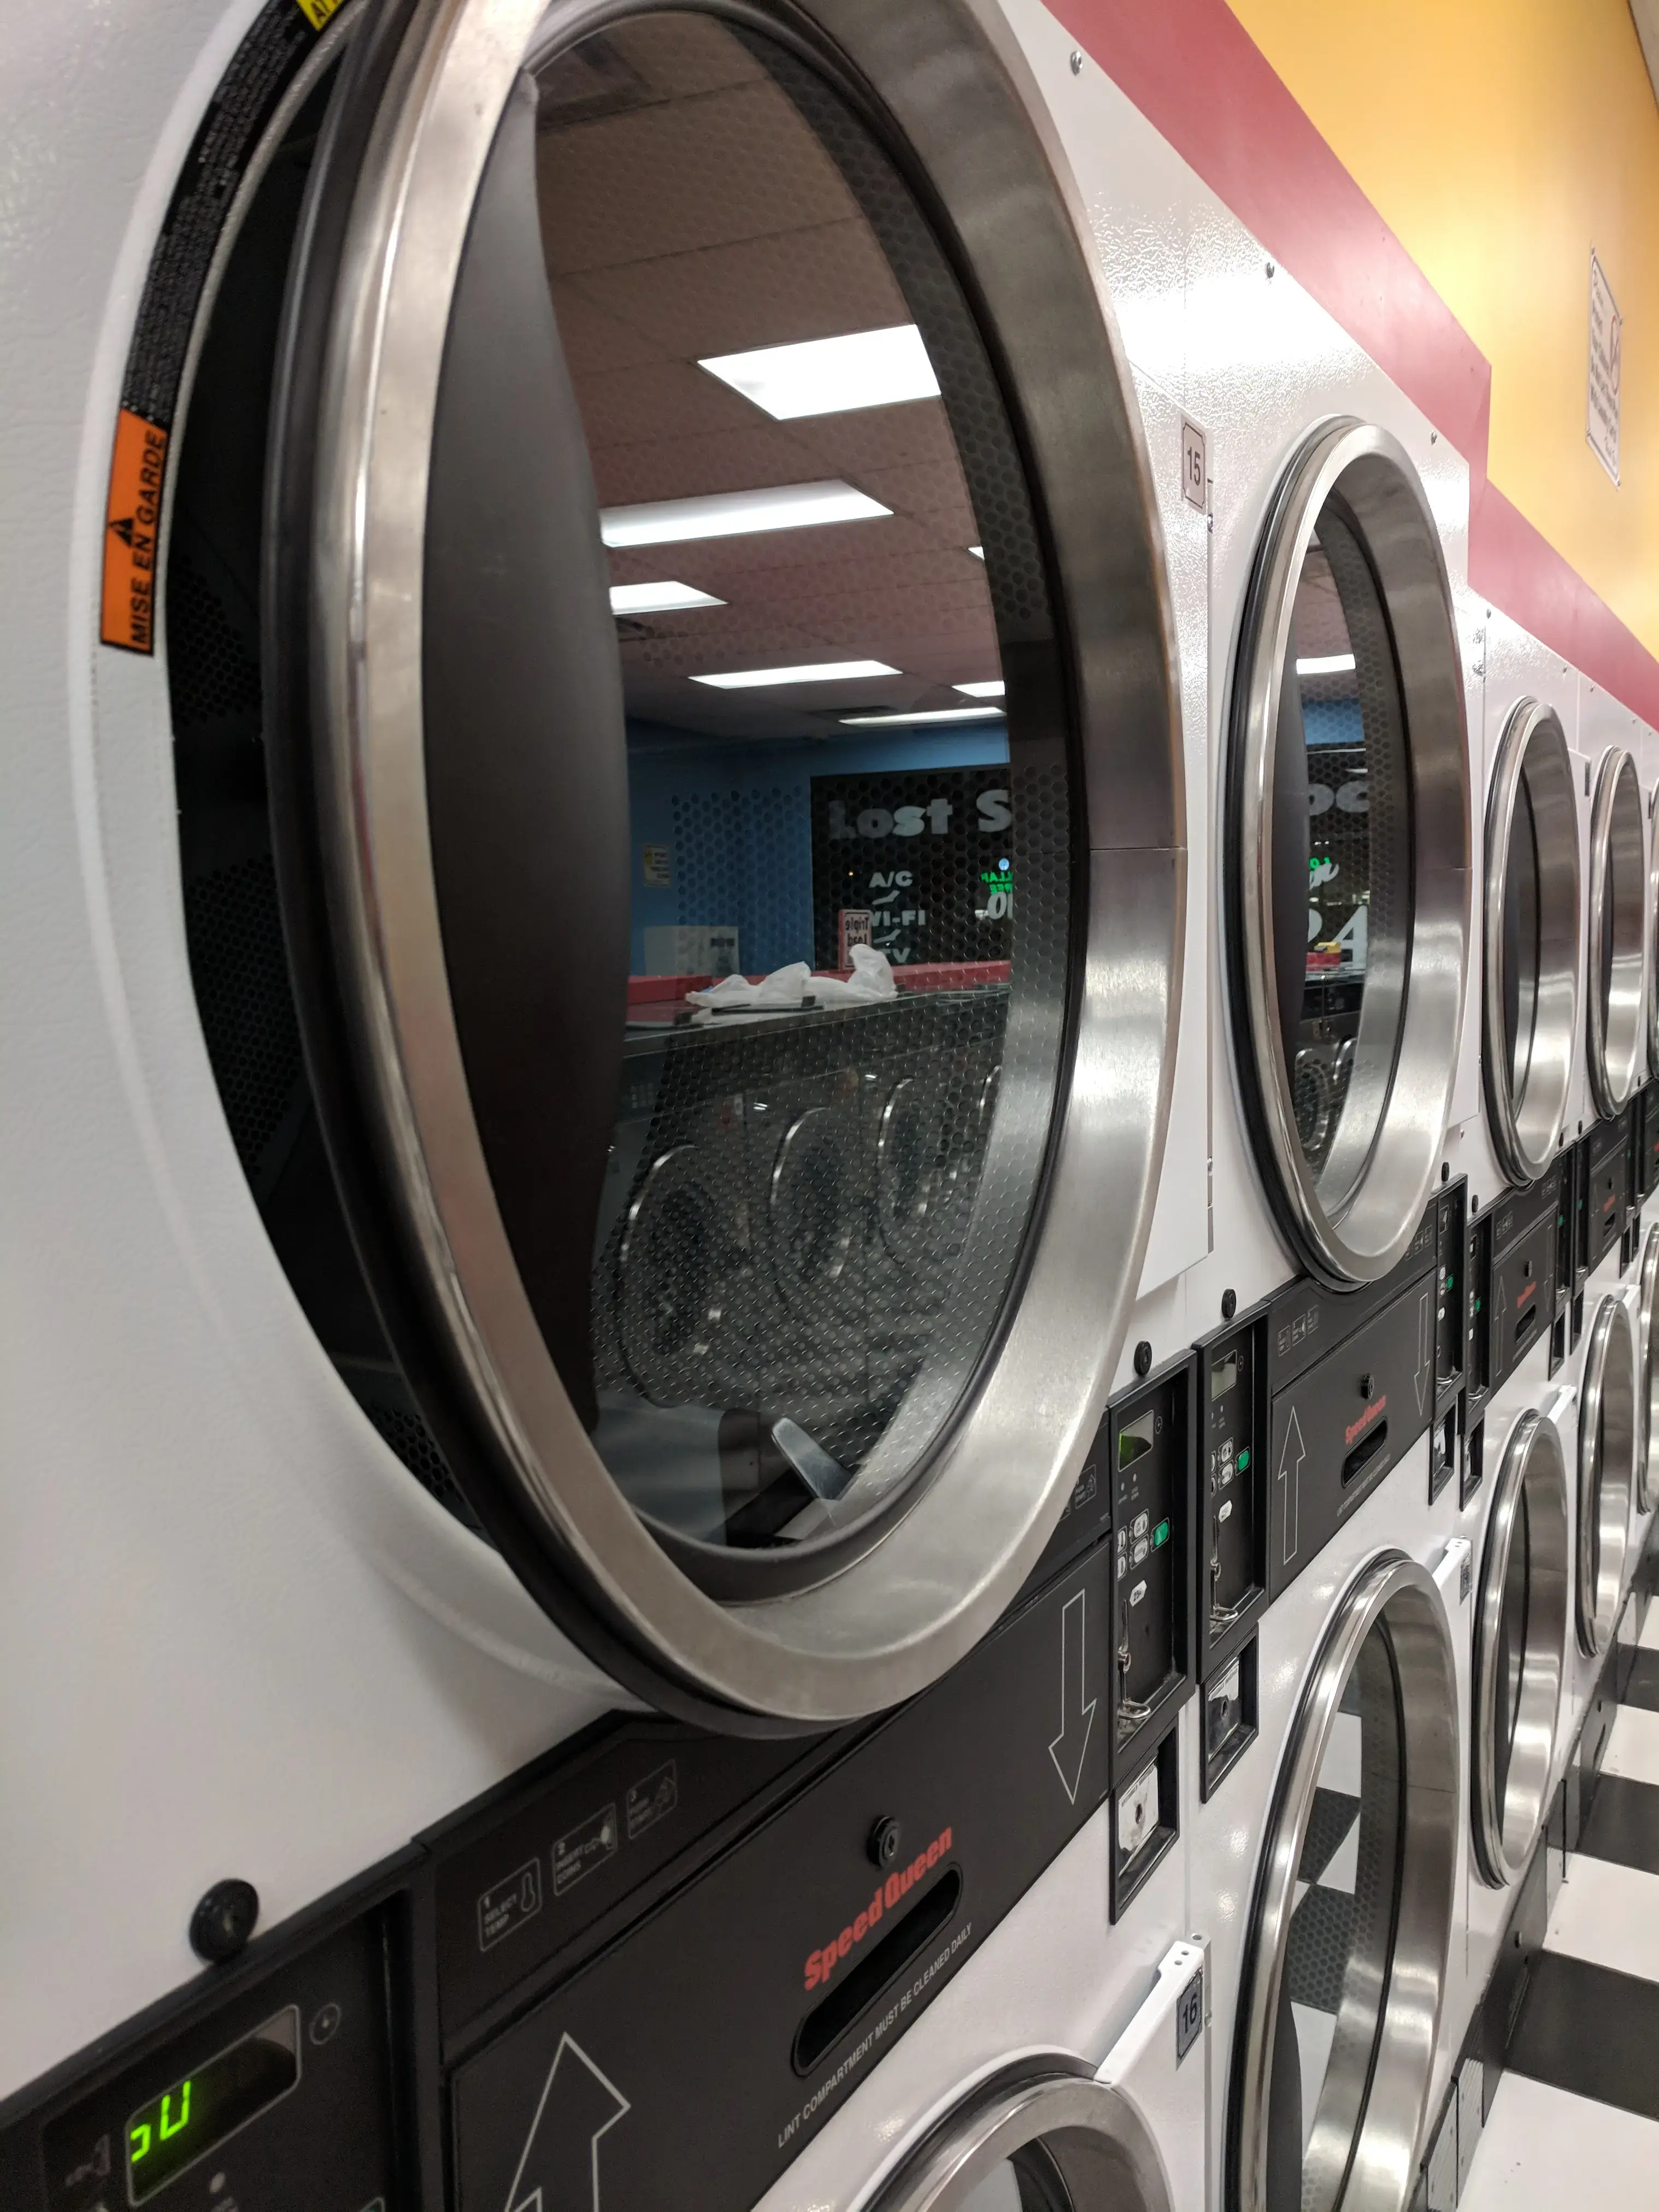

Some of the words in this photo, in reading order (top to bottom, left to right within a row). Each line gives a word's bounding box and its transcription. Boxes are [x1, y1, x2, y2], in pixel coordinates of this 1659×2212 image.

[136, 429, 164, 525] GARDE
[1187, 446, 1201, 486] 15
[131, 531, 152, 571] EN
[130, 578, 151, 644] MISE
[828, 798, 953, 839] Lost
[869, 870, 913, 888] A/C
[804, 1886, 884, 1991] Speed
[884, 1827, 953, 1908] Queen
[1183, 1993, 1197, 2033] 16
[778, 2115, 801, 2148] LINT
[803, 2032, 874, 2120] COMPARTMENT
[875, 2003, 899, 2040] MUST
[900, 1990, 912, 2011] BE
[913, 1947, 950, 1996] CLEANED
[951, 1922, 972, 1955] DAILY
